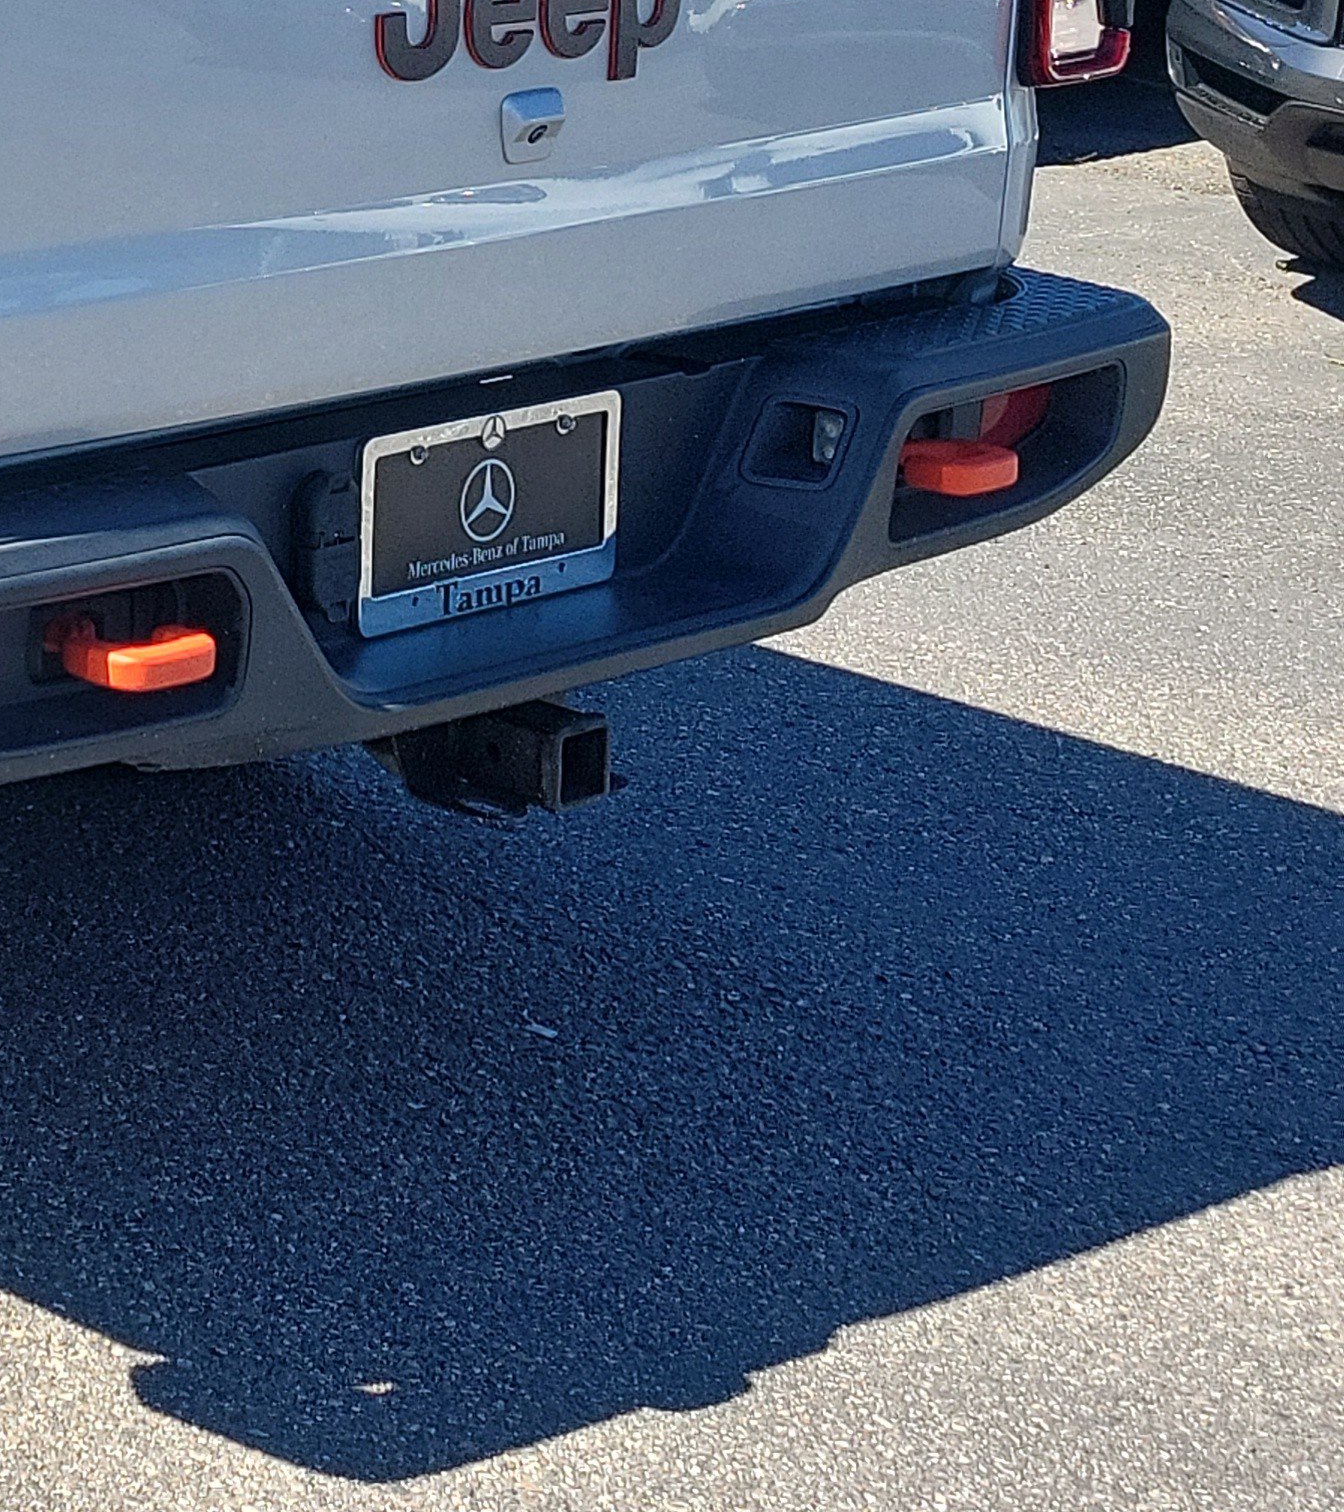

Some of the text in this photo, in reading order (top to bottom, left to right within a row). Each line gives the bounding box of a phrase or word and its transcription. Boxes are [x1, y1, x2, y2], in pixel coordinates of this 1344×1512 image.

[407, 530, 565, 579] Mercedes-Benz of Tampa
[436, 576, 541, 615] Tampa
